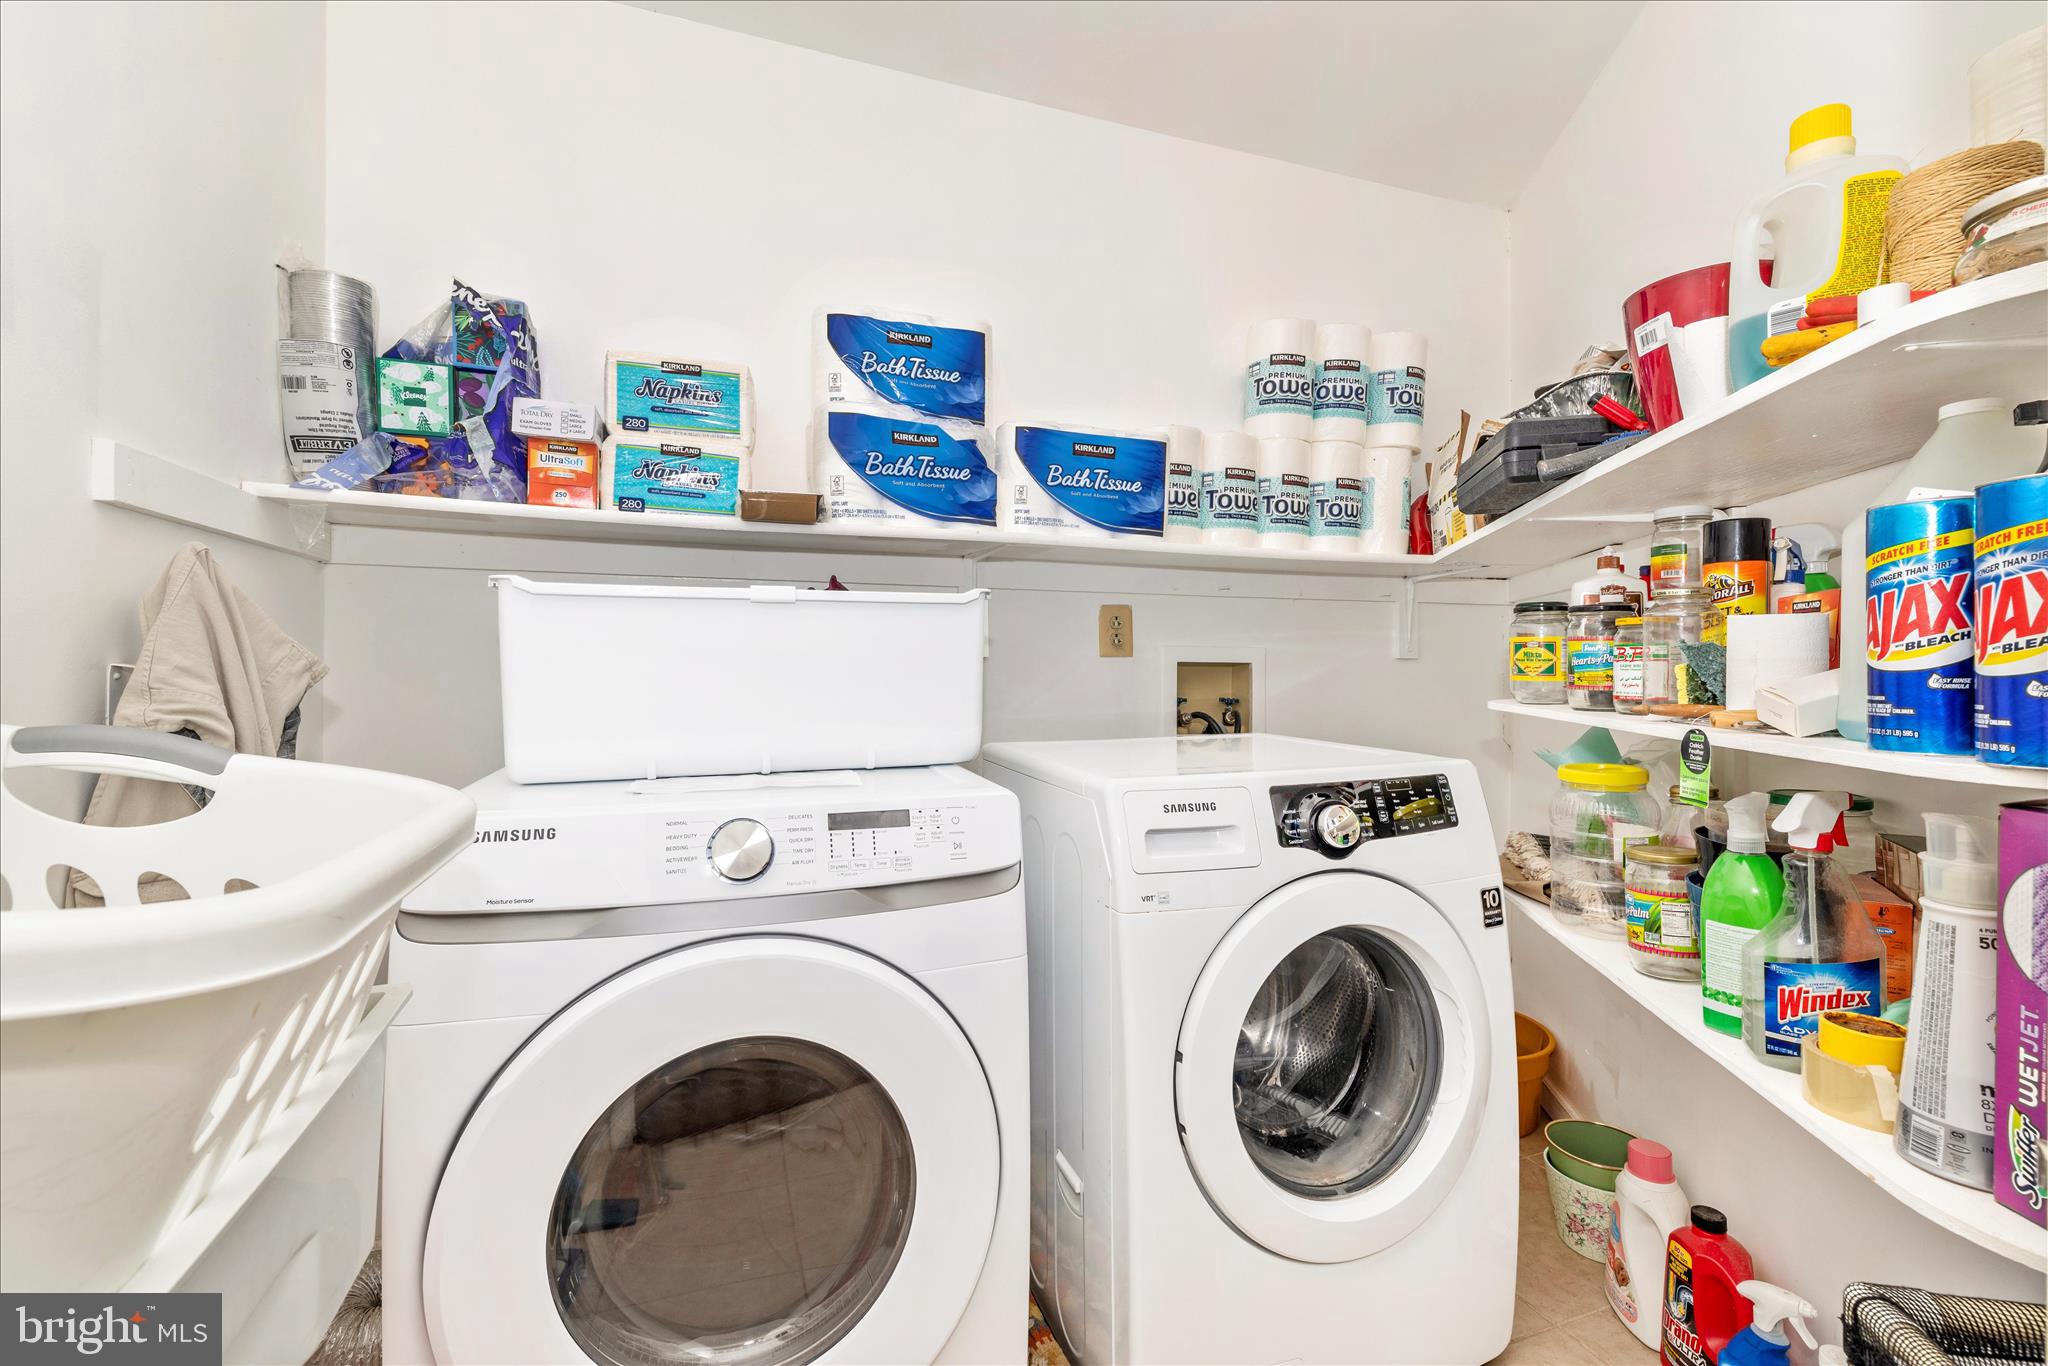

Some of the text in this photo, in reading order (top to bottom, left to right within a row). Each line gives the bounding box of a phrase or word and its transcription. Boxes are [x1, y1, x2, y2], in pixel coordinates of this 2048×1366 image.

[889, 331, 931, 343] KIRKLAND
[663, 362, 701, 372] KIRKLAND
[861, 351, 961, 383] Bath Tissue
[1326, 360, 1359, 368] KIRKLAND
[1268, 371, 1305, 379] PREMIUM
[1322, 377, 1359, 385] PREMIUM
[634, 378, 723, 405] Napkins
[1253, 376, 1315, 399] Towel
[1385, 386, 1424, 406] Tow
[520, 409, 540, 418] TOTAL
[625, 418, 646, 428] 280
[894, 432, 937, 443] KIRKLAND
[549, 445, 578, 453] KIRKLAND
[663, 444, 700, 455] KIRKLAND
[1075, 443, 1115, 454] KIRKLAND
[540, 453, 584, 466] UltraSoft
[864, 451, 972, 481] Bath Tissue
[1170, 463, 1191, 472] KLAND
[1227, 468, 1255, 477] KIRKLAND
[1047, 464, 1143, 493] Bath Tissue
[621, 500, 643, 509] 280
[1168, 489, 1200, 509] wel
[1205, 489, 1258, 510] Towe
[1315, 499, 1361, 519] Tow
[1872, 544, 1914, 565] SCRATCH
[2002, 555, 2028, 569] THAN
[2030, 549, 2048, 562] DIR
[1905, 565, 1929, 577] THAN
[1793, 601, 1821, 610] KIRKLAND
[1867, 572, 1971, 661] AJAX
[1904, 630, 1971, 651] BLEACH
[2001, 635, 2048, 654] BLEA
[1163, 802, 1217, 813] SAMSUNG
[1483, 890, 1500, 908] 10
[1778, 985, 1871, 1022] Windex
[1780, 1025, 1817, 1035] ADV
[2018, 1005, 2040, 1107] WETJET
[2012, 1113, 2041, 1210] Swiffer
[1663, 1307, 1702, 1356] Drano
